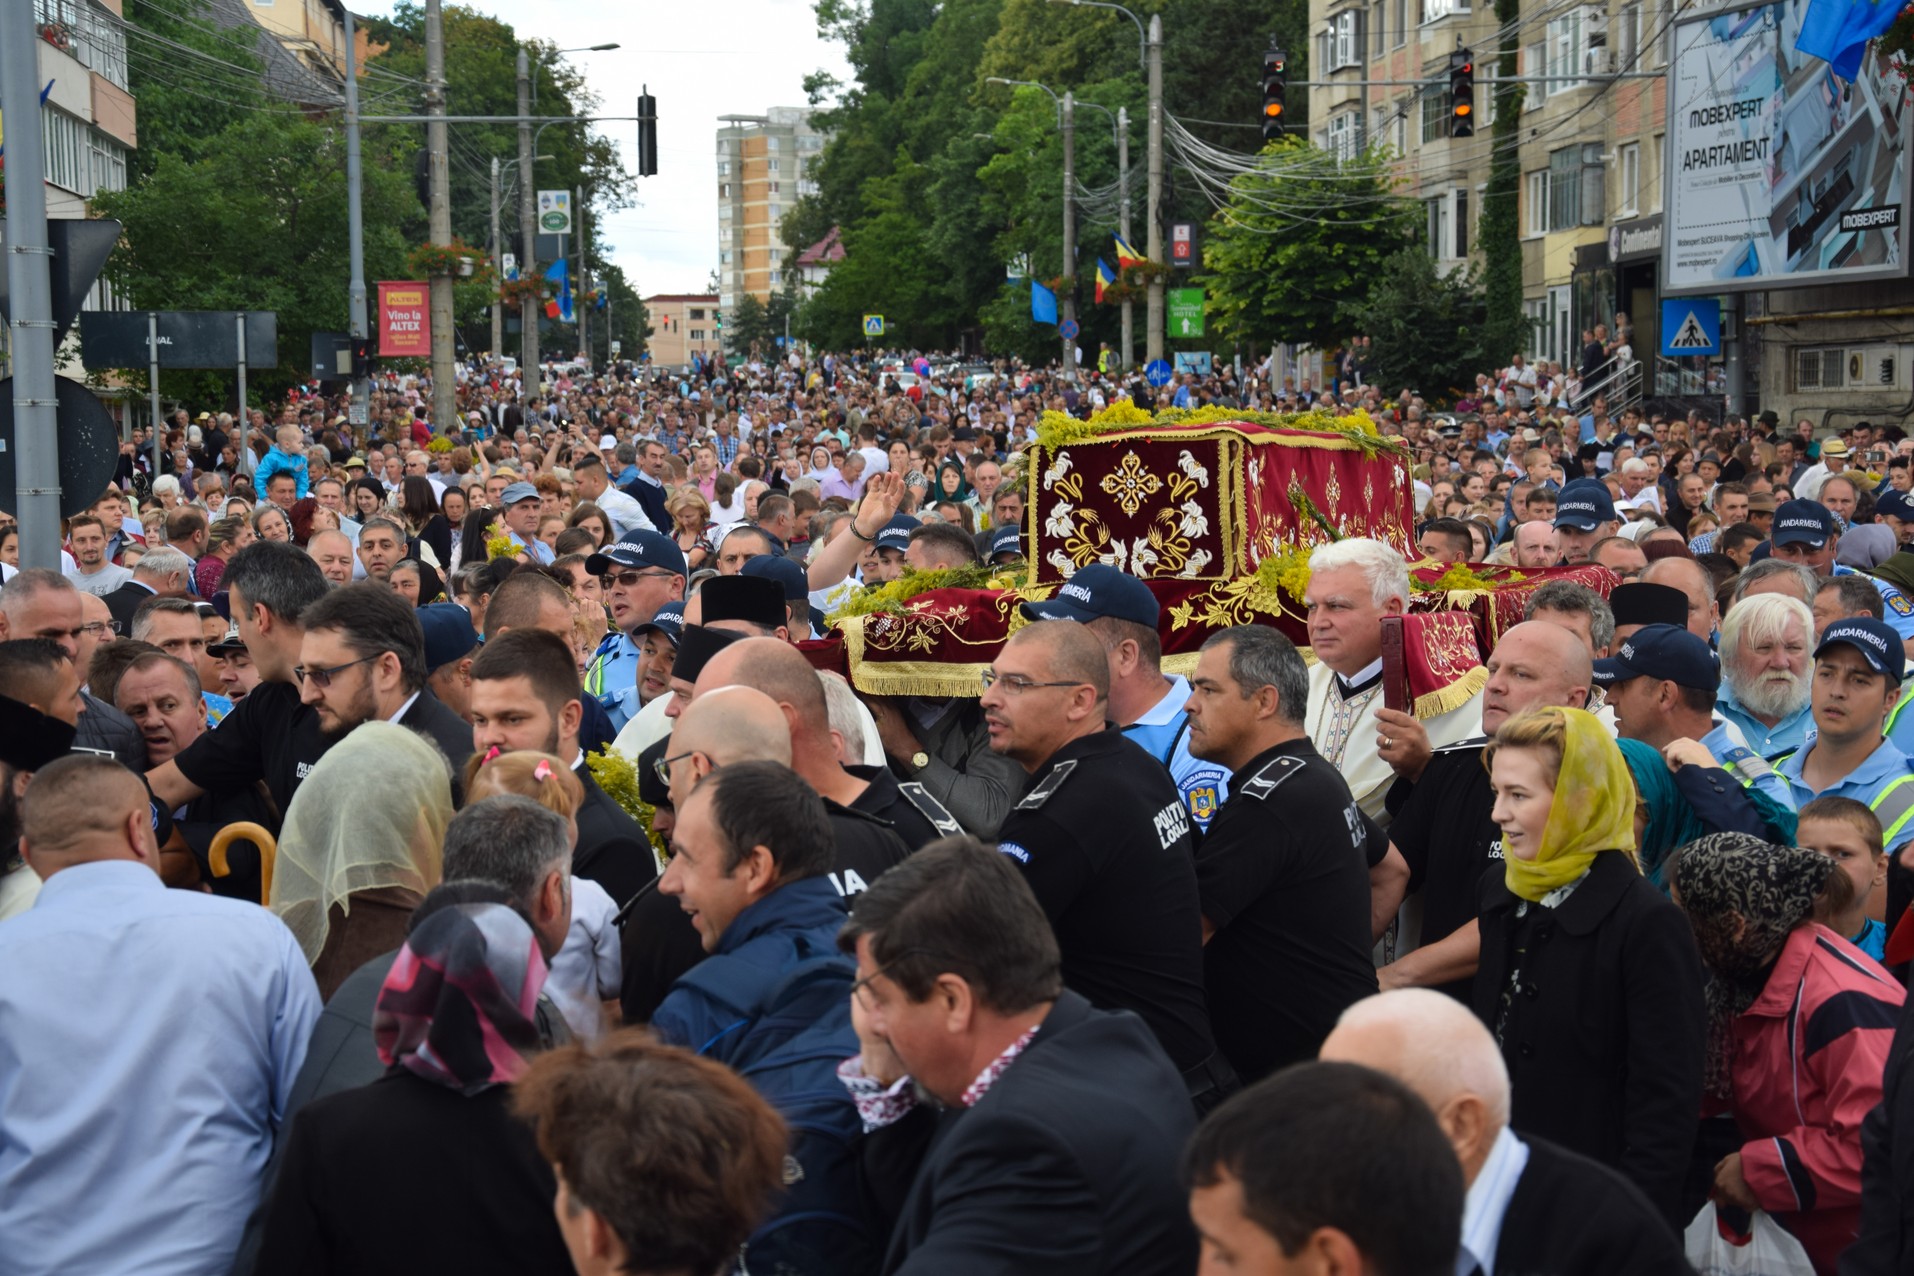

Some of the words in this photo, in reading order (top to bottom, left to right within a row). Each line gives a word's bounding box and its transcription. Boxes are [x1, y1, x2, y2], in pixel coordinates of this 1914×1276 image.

[1689, 97, 1764, 128] MOBEXPERT
[1683, 137, 1770, 171] APARTAMENT
[1842, 208, 1897, 228] MOBEXPERT
[387, 310, 410, 320] Vino
[412, 310, 422, 320] la
[390, 321, 421, 331] ALTEX
[1160, 817, 1190, 851] LOCAL
